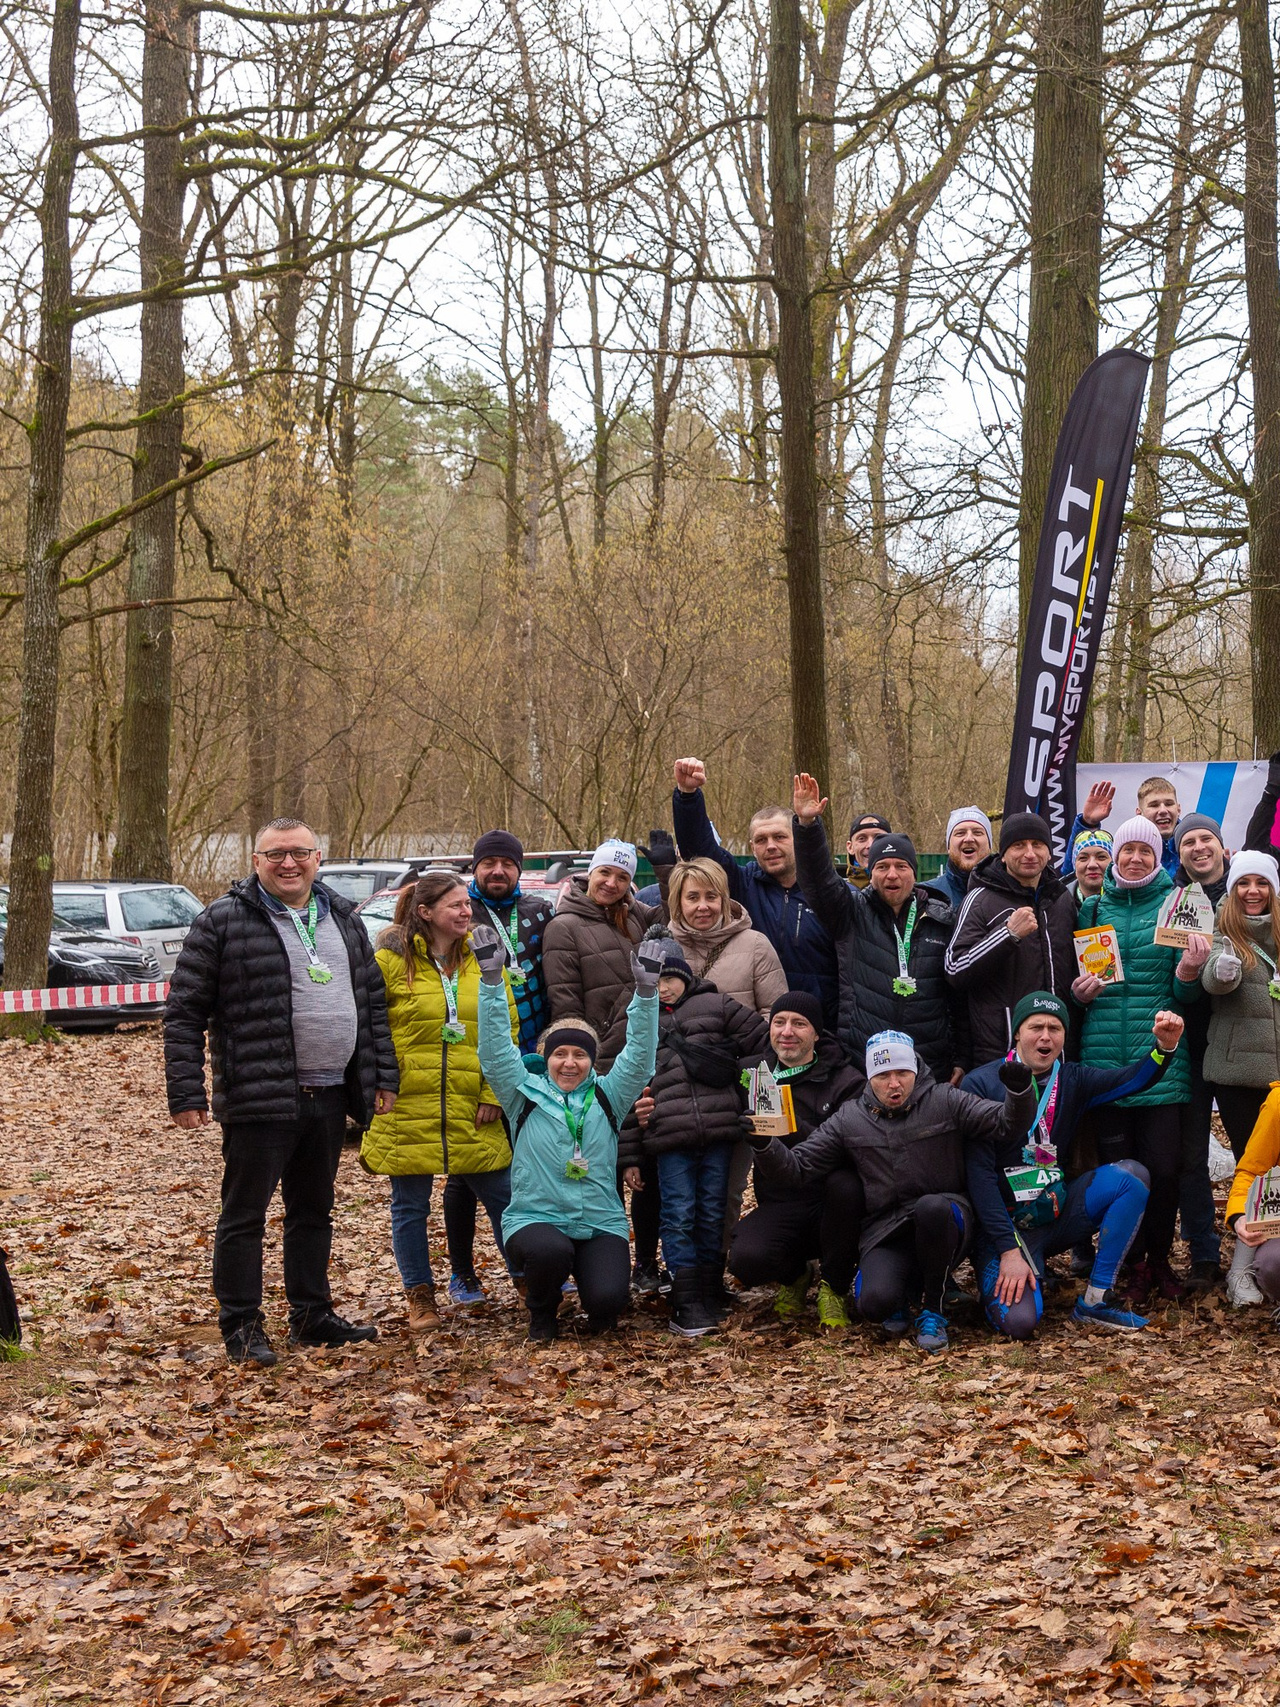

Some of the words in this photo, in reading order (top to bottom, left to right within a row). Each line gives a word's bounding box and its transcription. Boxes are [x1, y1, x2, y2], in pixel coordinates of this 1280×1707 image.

[1024, 464, 1091, 813] SPORT
[1173, 915, 1202, 929] TRAIL
[874, 1058, 891, 1067] FUN
